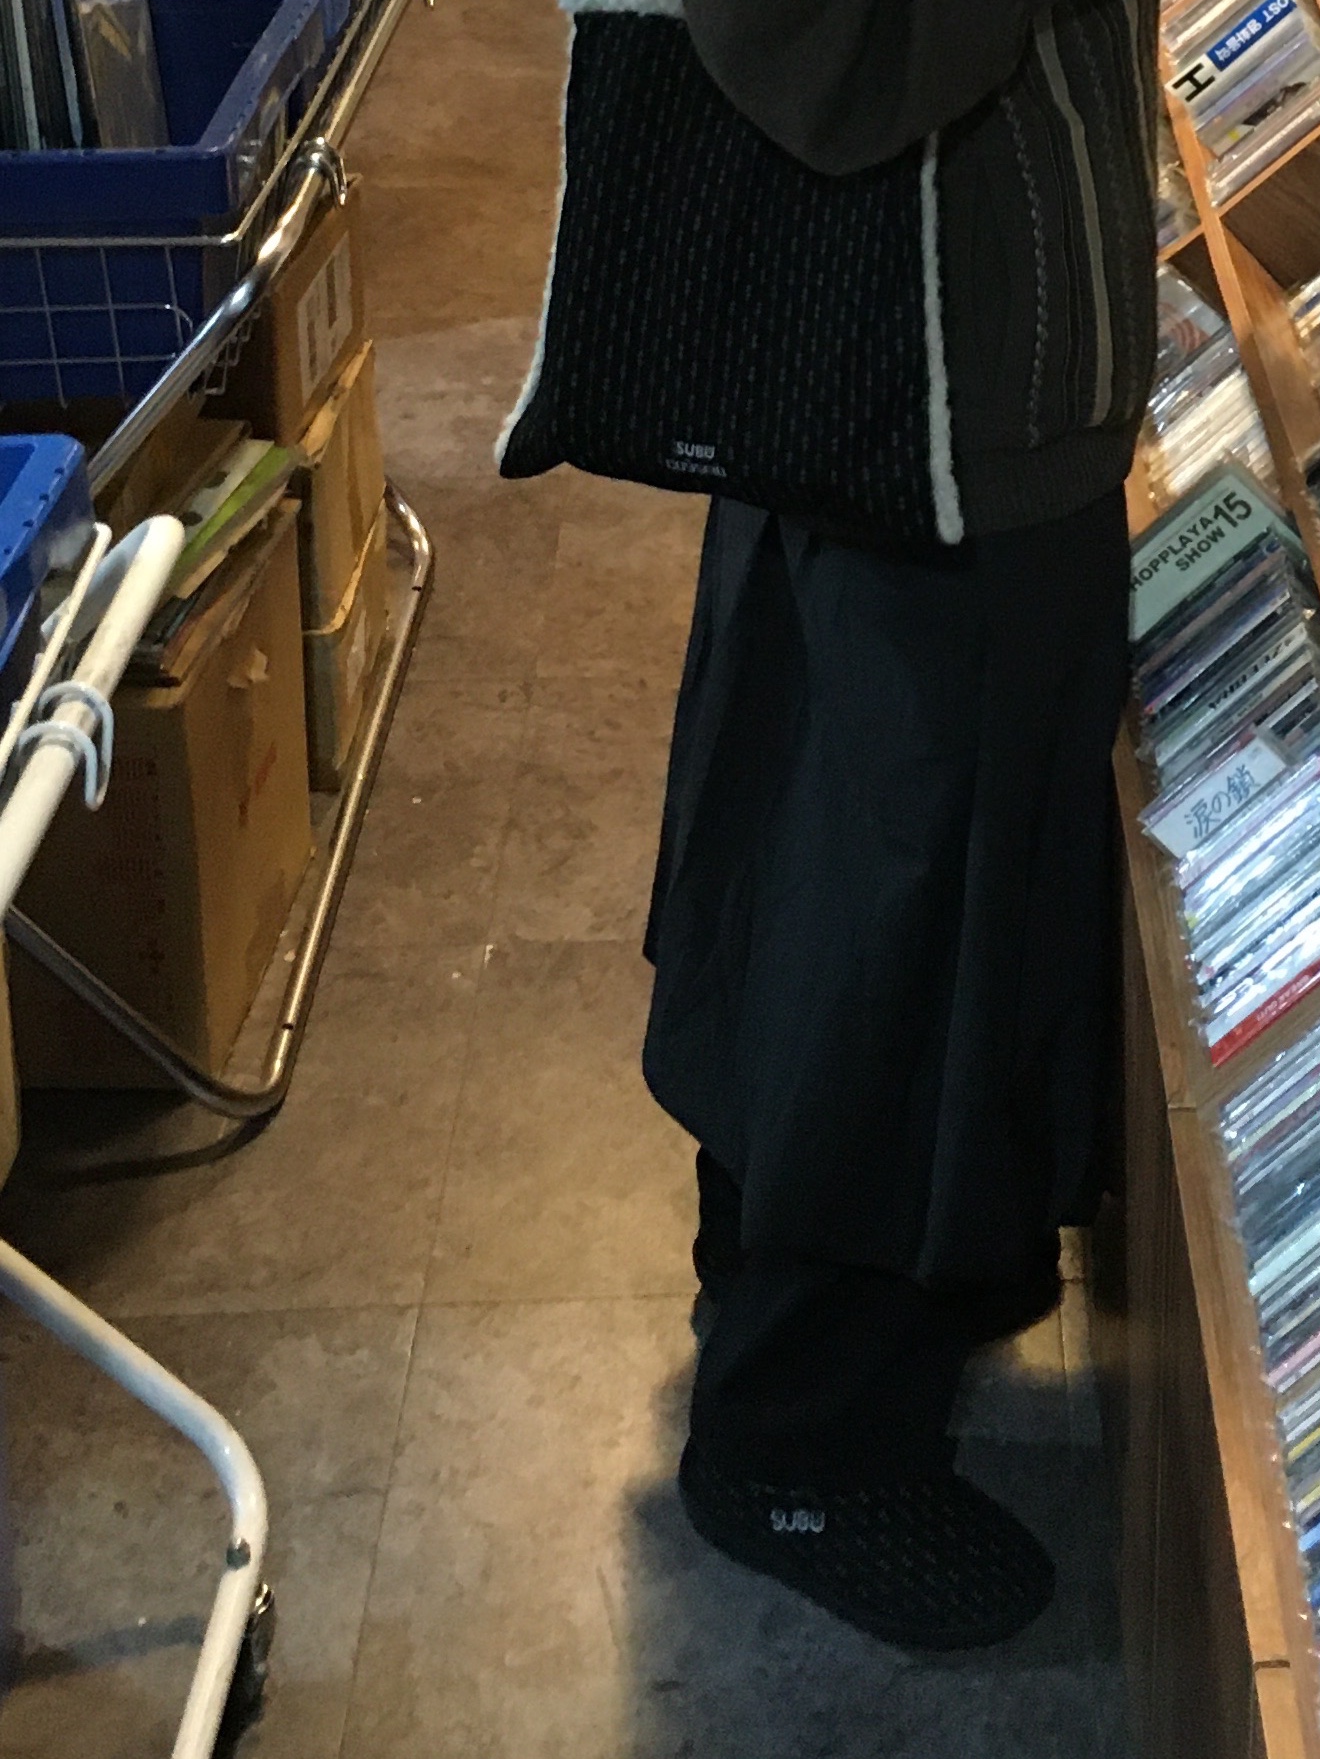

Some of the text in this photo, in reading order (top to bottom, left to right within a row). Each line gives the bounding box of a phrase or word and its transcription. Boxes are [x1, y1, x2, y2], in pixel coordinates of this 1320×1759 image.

[1171, 63, 1217, 103] H
[1175, 489, 1255, 572] SHOW 15
[769, 1508, 826, 1533] SUBU
